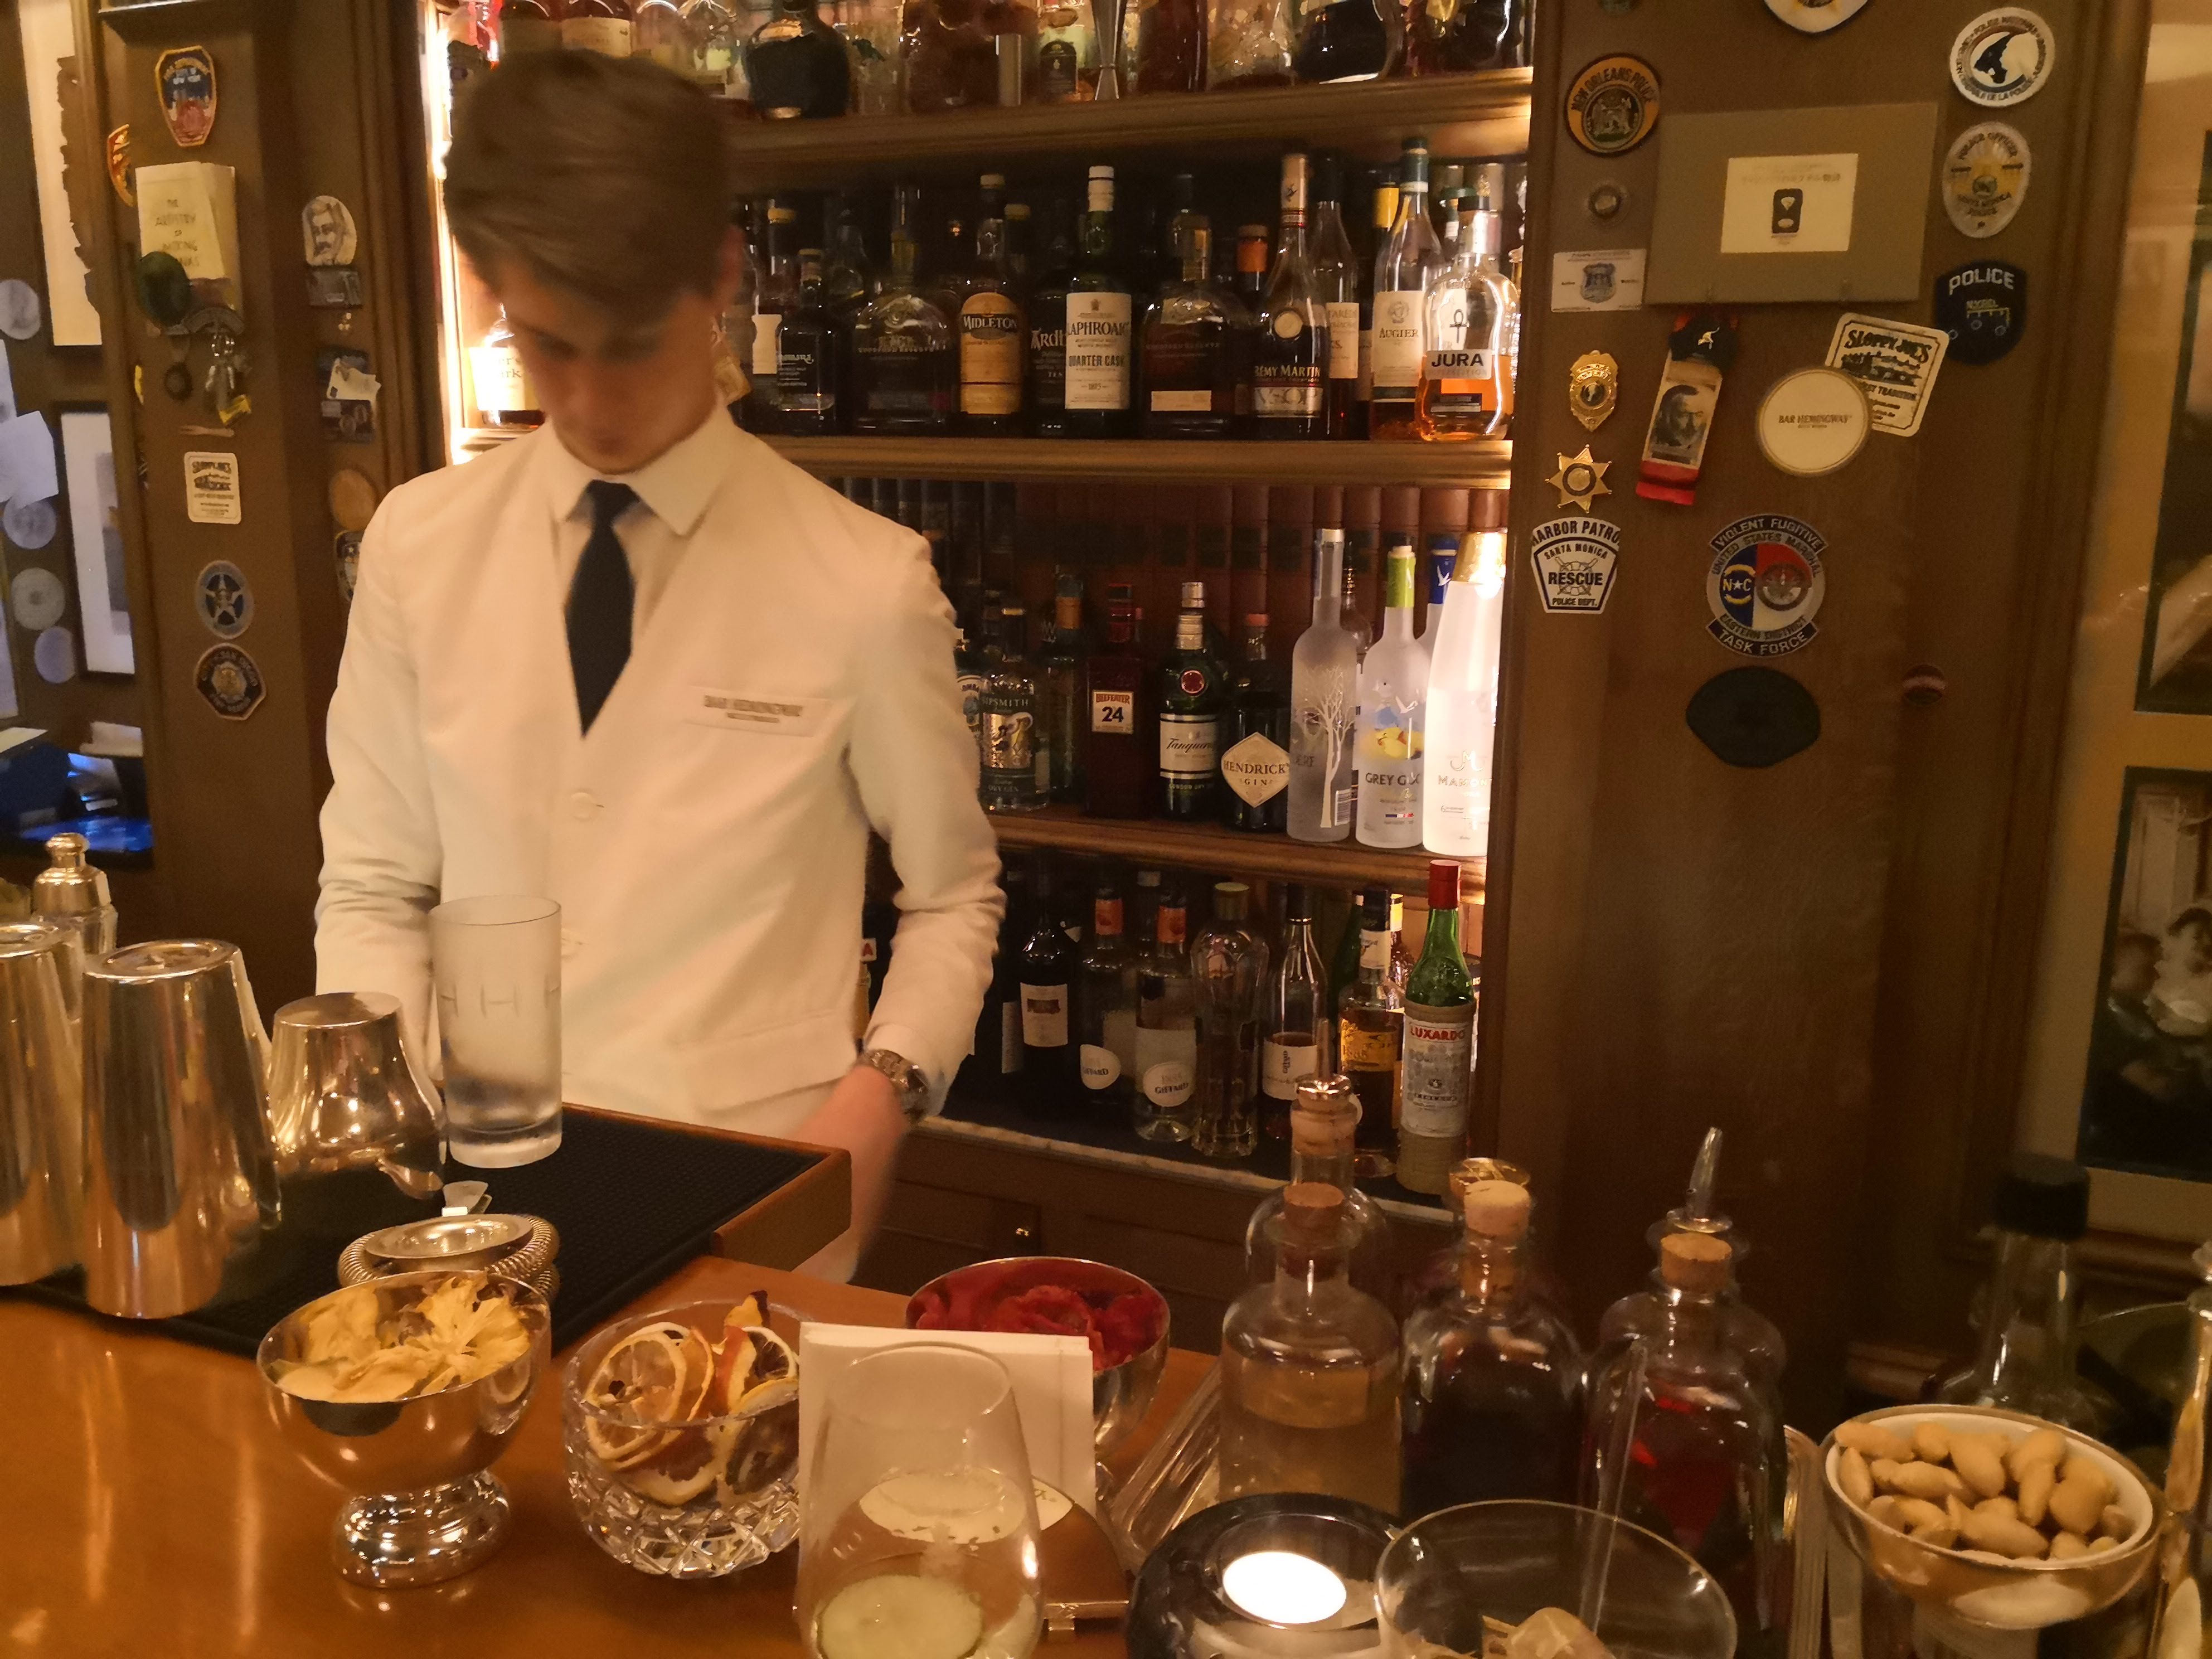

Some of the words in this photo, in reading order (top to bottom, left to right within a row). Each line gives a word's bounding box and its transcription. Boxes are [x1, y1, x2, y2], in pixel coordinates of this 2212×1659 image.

[1949, 268, 2015, 295] POLICE
[1379, 327, 1418, 338] AUGIER
[1431, 353, 1484, 367] JURA
[1280, 364, 1321, 377] MARTIN
[1581, 521, 1620, 545] PATRO
[1715, 518, 1765, 547] VIOLENT
[1770, 518, 1822, 550] FUGITIVE
[1544, 543, 1571, 560] SANTA
[1575, 543, 1609, 560] MONICA
[1548, 571, 1604, 586] RESCUE
[1552, 598, 1576, 606] POLICE
[1719, 629, 1754, 654] TASK
[1760, 631, 1808, 656] FORCE
[1096, 693, 1131, 705] BEEFEATER
[1102, 706, 1124, 723] 24
[1365, 772, 1394, 785] GREY
[1438, 774, 1492, 787] MAMON
[1410, 1026, 1466, 1041] LUXARDO
